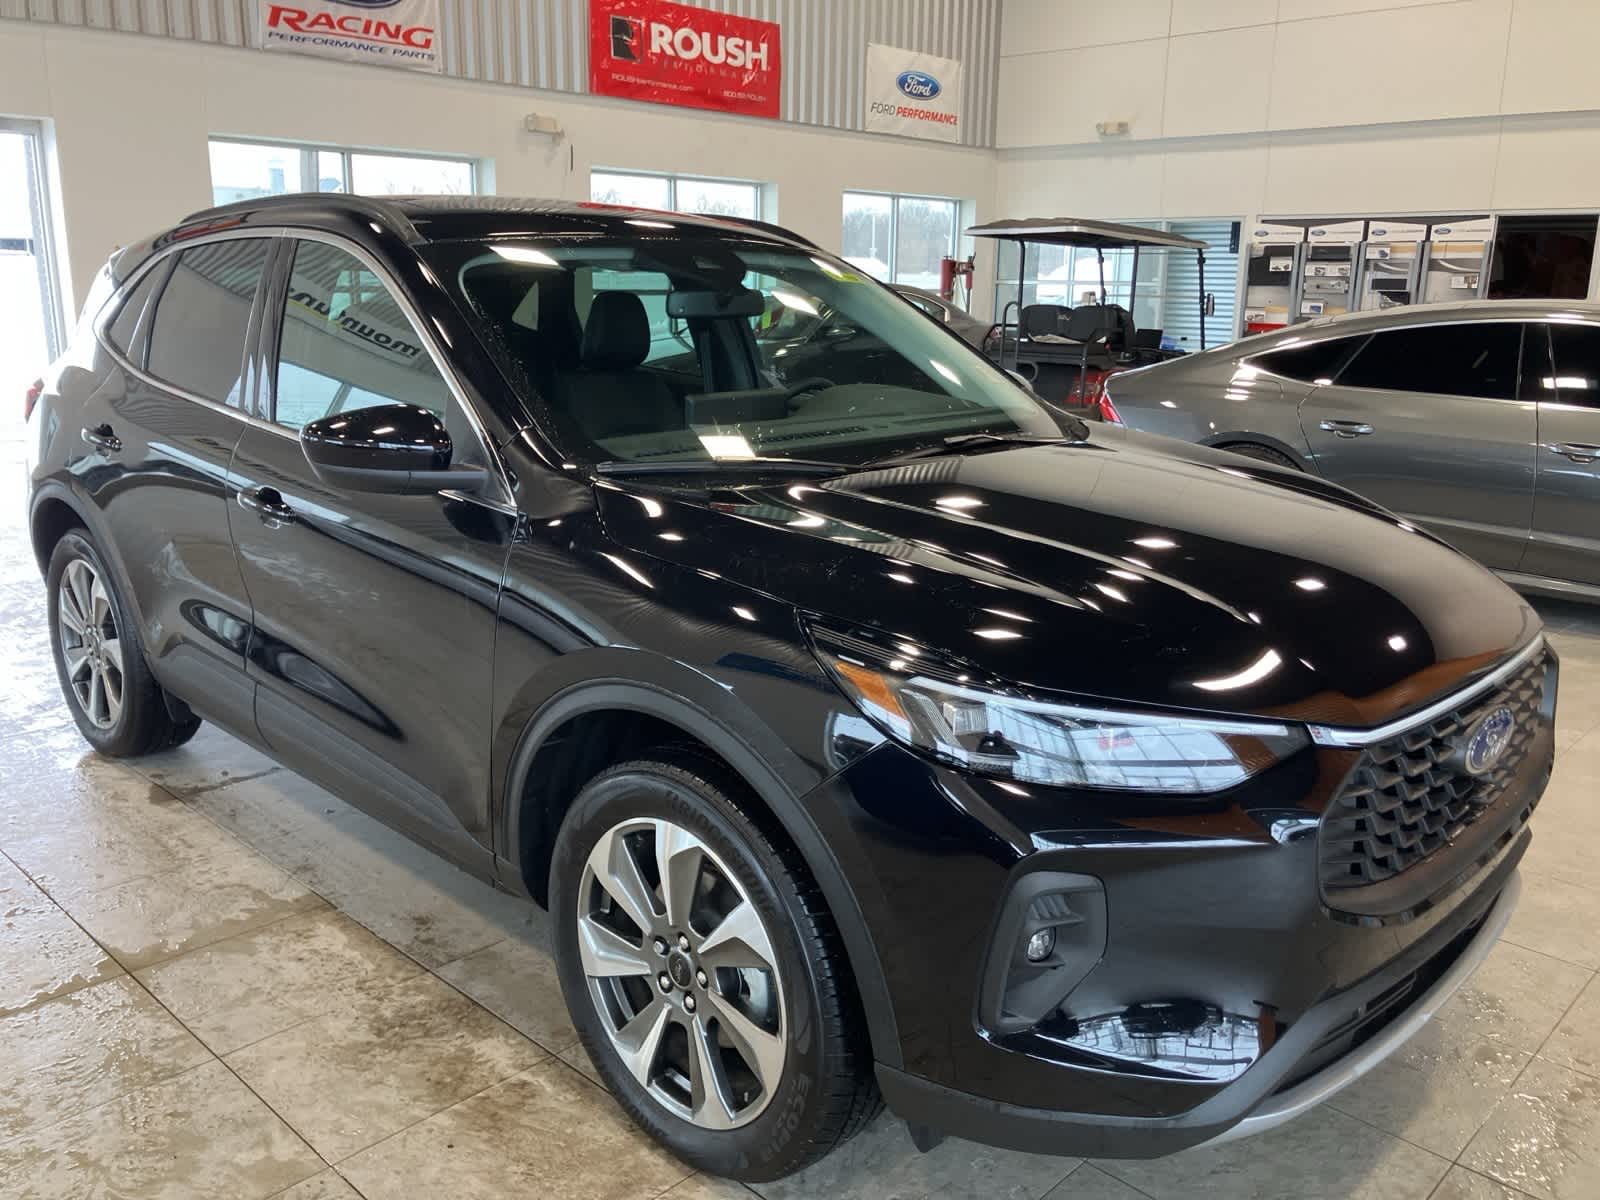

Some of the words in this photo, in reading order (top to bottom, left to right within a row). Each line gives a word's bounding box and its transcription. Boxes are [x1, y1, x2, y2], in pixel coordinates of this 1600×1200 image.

[268, 5, 434, 49] RACING
[268, 31, 387, 55] PERFORMANCE
[392, 48, 435, 61] PARTS
[650, 22, 768, 71] ROUSH
[904, 75, 932, 96] Ford
[870, 102, 895, 115] FORD
[896, 106, 958, 126] PERFORMANCE
